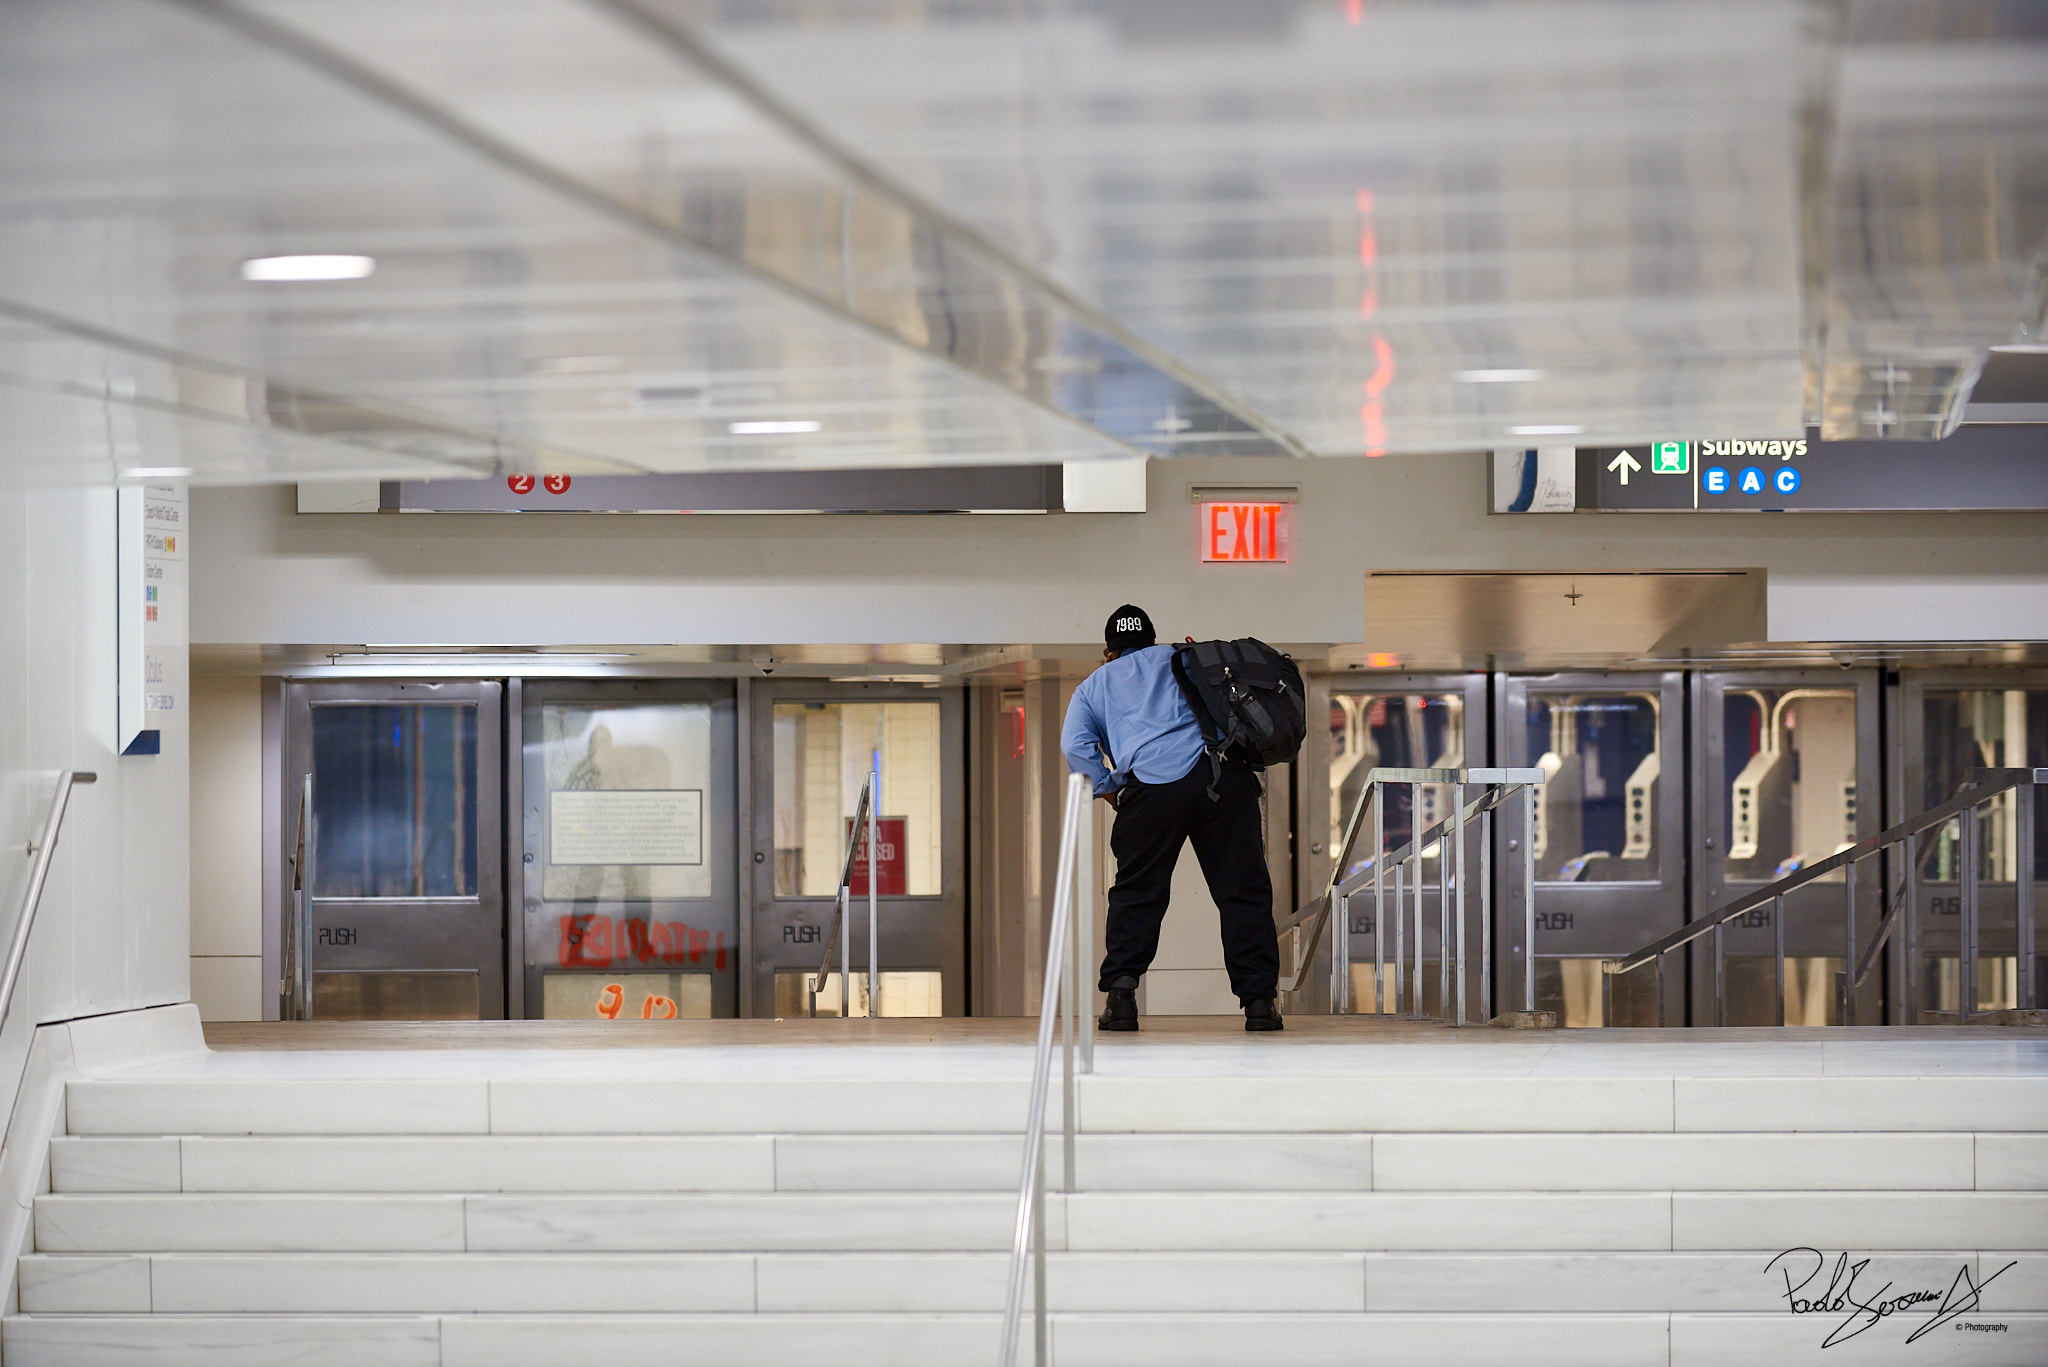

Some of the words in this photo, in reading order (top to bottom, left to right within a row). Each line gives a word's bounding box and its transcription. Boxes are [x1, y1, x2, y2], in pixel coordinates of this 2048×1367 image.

[1701, 438, 1808, 461] Subways
[514, 472, 528, 490] 2
[550, 472, 564, 490] 3
[1708, 471, 1725, 491] E
[1742, 471, 1760, 491] A
[1777, 471, 1795, 492] C
[1211, 505, 1281, 560] EXIT
[1116, 617, 1142, 632] 1989
[855, 843, 895, 861] CLSED
[1931, 896, 1960, 916] PUS
[1348, 915, 1377, 935] USH
[1536, 912, 1574, 930] PUSH
[319, 927, 357, 945] PUSH
[783, 925, 821, 943] PUSH
